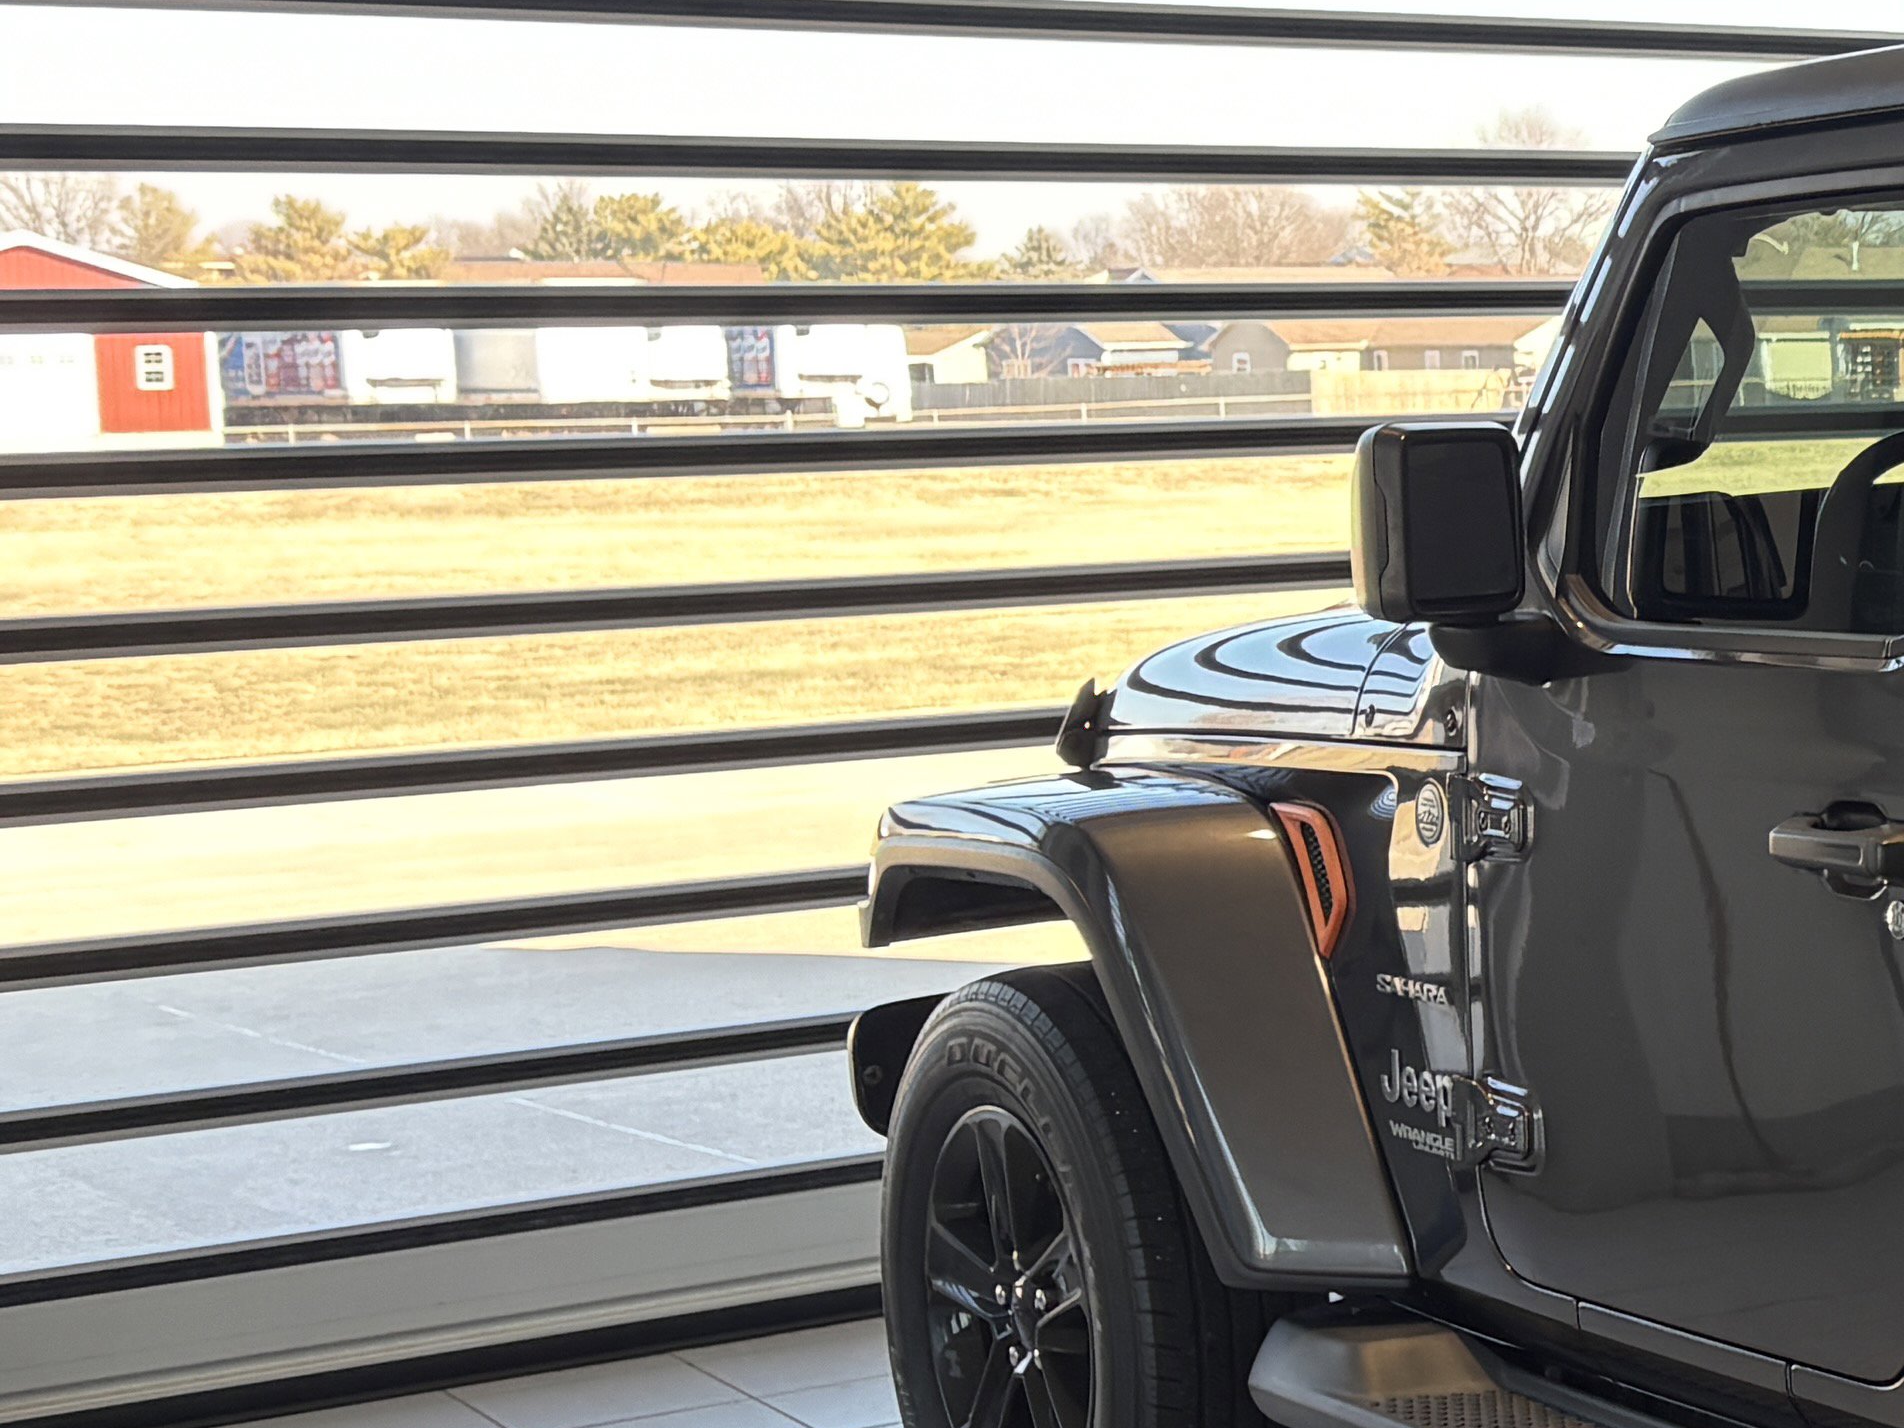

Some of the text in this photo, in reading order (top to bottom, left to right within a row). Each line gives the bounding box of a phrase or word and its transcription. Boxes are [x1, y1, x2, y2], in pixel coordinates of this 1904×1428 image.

[1377, 973, 1449, 1005] SAHARA
[1380, 1048, 1454, 1128] Jeep
[1389, 1119, 1455, 1153] WRANGLE
